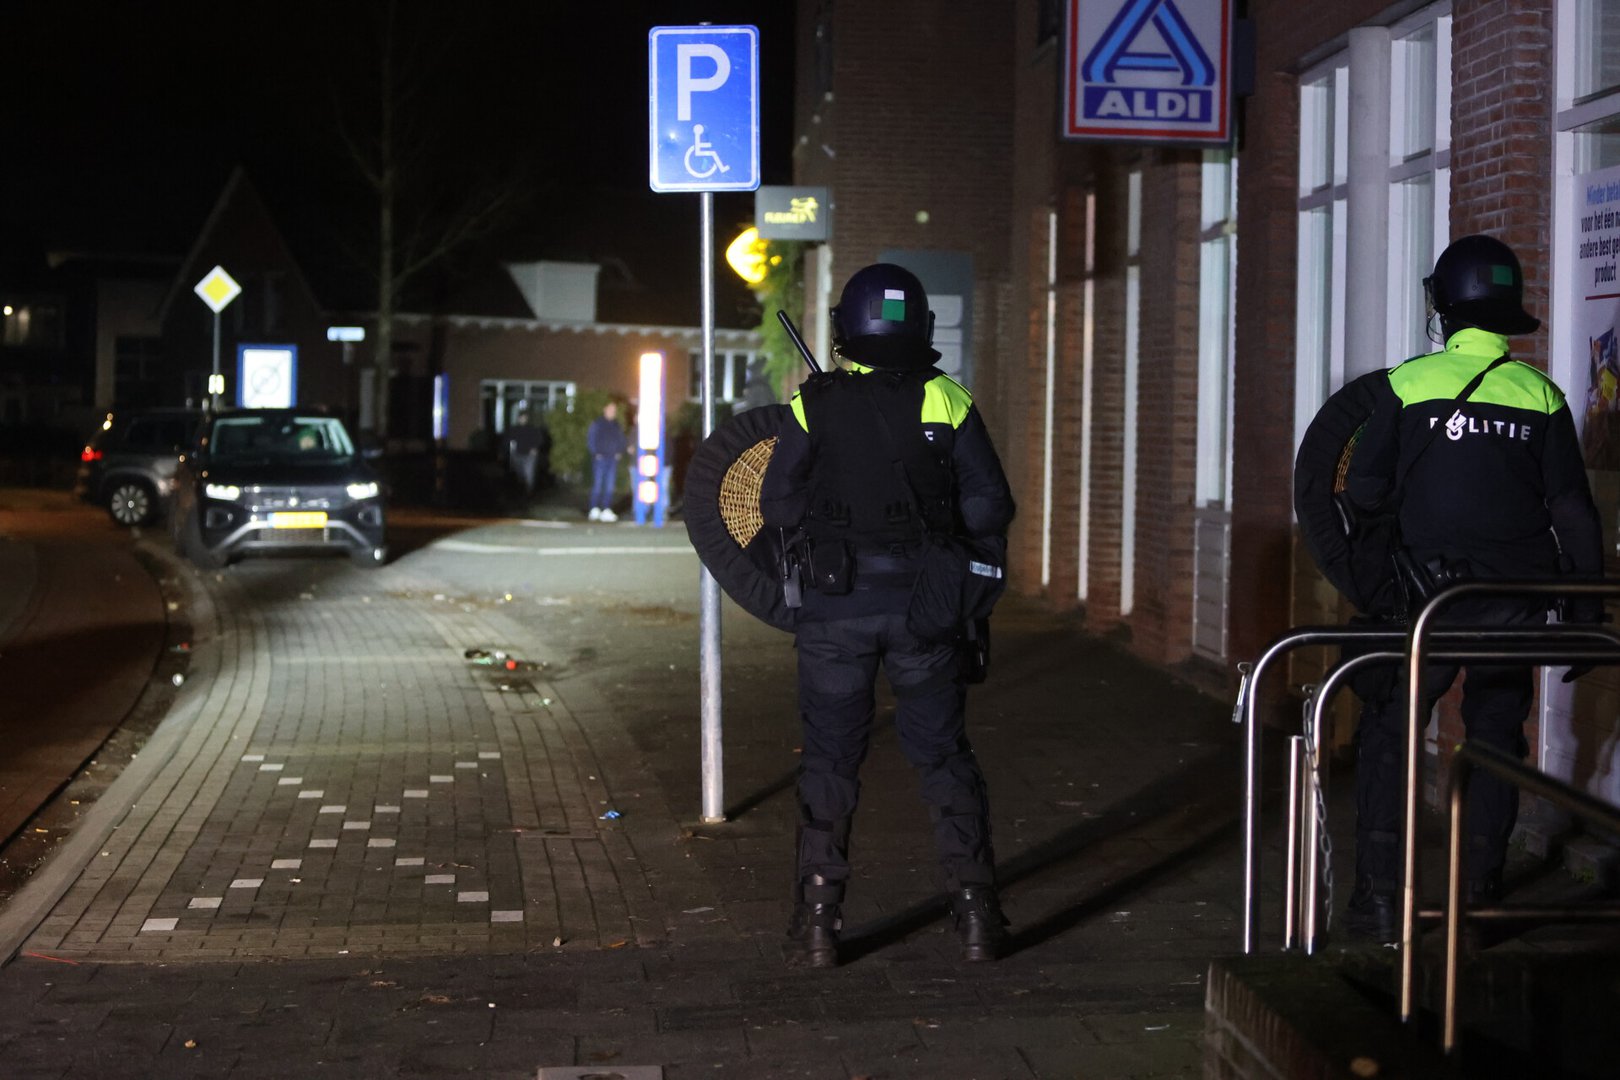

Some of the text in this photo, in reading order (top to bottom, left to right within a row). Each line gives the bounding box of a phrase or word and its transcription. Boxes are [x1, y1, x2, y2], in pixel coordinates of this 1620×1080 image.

[677, 44, 731, 121] P
[1096, 90, 1200, 119] ALDI
[1586, 184, 1606, 205] Minder
[1581, 216, 1593, 232] voor
[1594, 210, 1603, 231] het
[1604, 207, 1614, 229] één
[1579, 238, 1598, 259] andere
[1599, 236, 1611, 256] best
[1594, 261, 1616, 288] product
